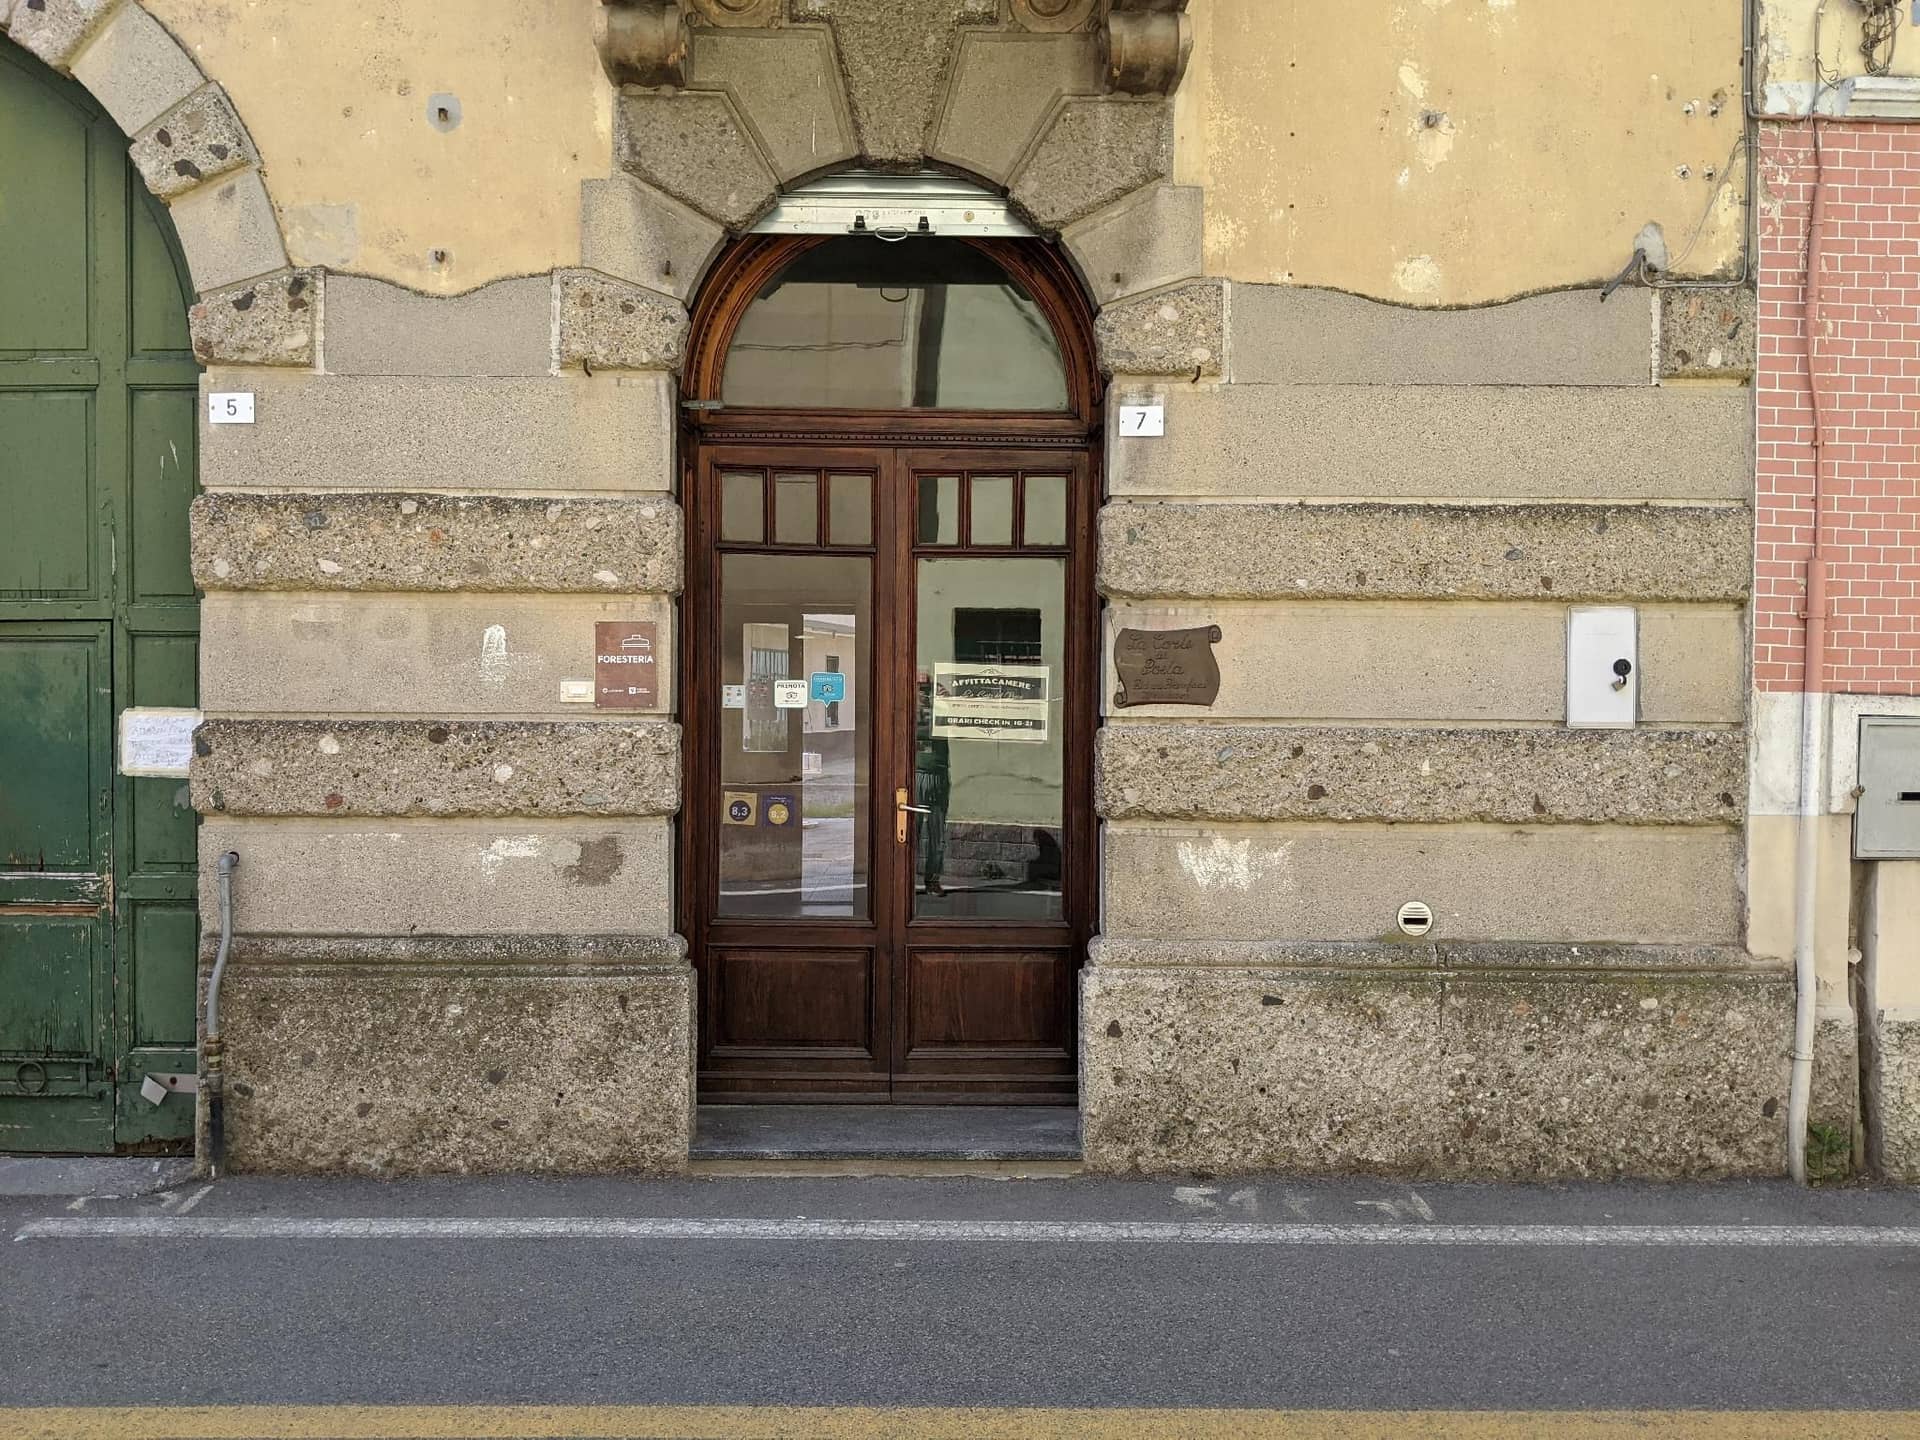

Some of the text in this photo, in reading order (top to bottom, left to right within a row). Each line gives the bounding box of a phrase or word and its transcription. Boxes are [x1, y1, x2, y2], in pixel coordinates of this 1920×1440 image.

[226, 398, 237, 416] 5
[1136, 412, 1147, 430] 7
[597, 655, 655, 665] FORESTERIA
[951, 677, 1032, 691] AFFITTACAMERE
[947, 717, 973, 725] ORARI
[973, 718, 1000, 726] CHECK
[1001, 719, 1011, 727] IN
[731, 806, 748, 817] 8,3
